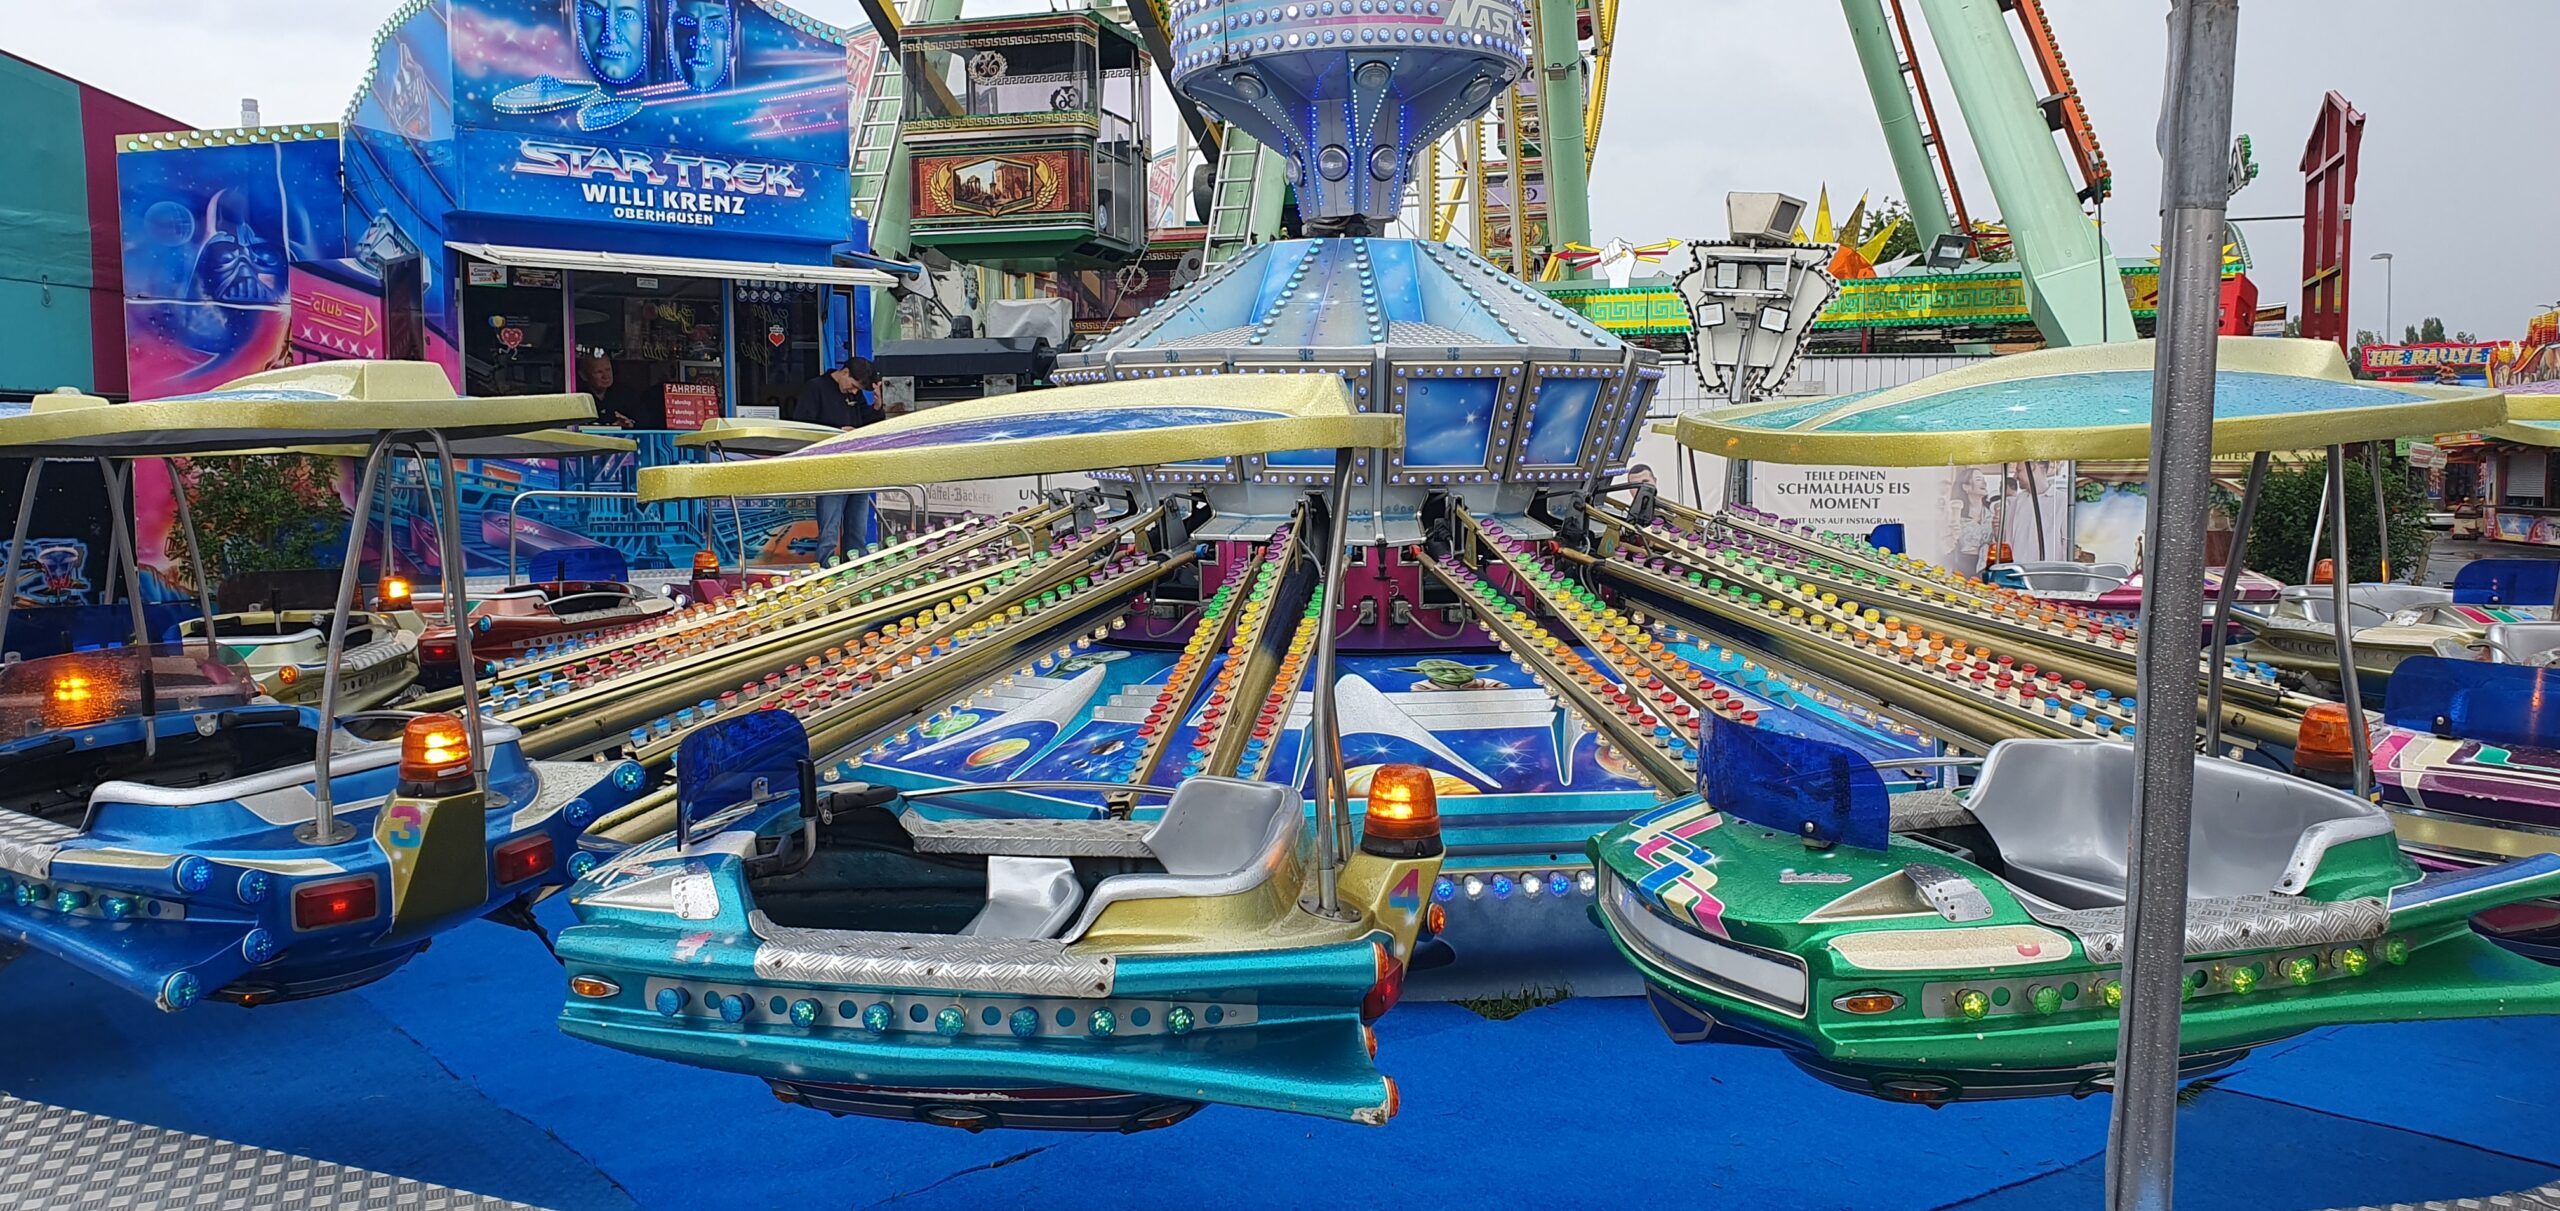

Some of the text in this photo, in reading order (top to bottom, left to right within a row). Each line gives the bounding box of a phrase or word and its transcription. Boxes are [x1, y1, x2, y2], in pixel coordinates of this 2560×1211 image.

[1445, 0, 1514, 40] NASA
[979, 60, 998, 76] 36
[512, 140, 805, 198] STAR TREK
[582, 182, 746, 215] WILLI KRENZ
[613, 207, 714, 226] OBERHAUSEN
[313, 298, 342, 317] club
[2370, 347, 2481, 367] THE RALLYE
[665, 384, 716, 394] FAHRPREIS
[1805, 471, 1886, 481] TEILE DEINEN
[1777, 482, 1910, 494] SCHMALHAUS EIS
[1809, 498, 1880, 509] MOMENT
[1808, 517, 1826, 525] UNS
[1828, 517, 1845, 525] AUF
[1389, 580, 1399, 597] 5
[390, 805, 422, 848] 3
[1388, 867, 1420, 918] 4
